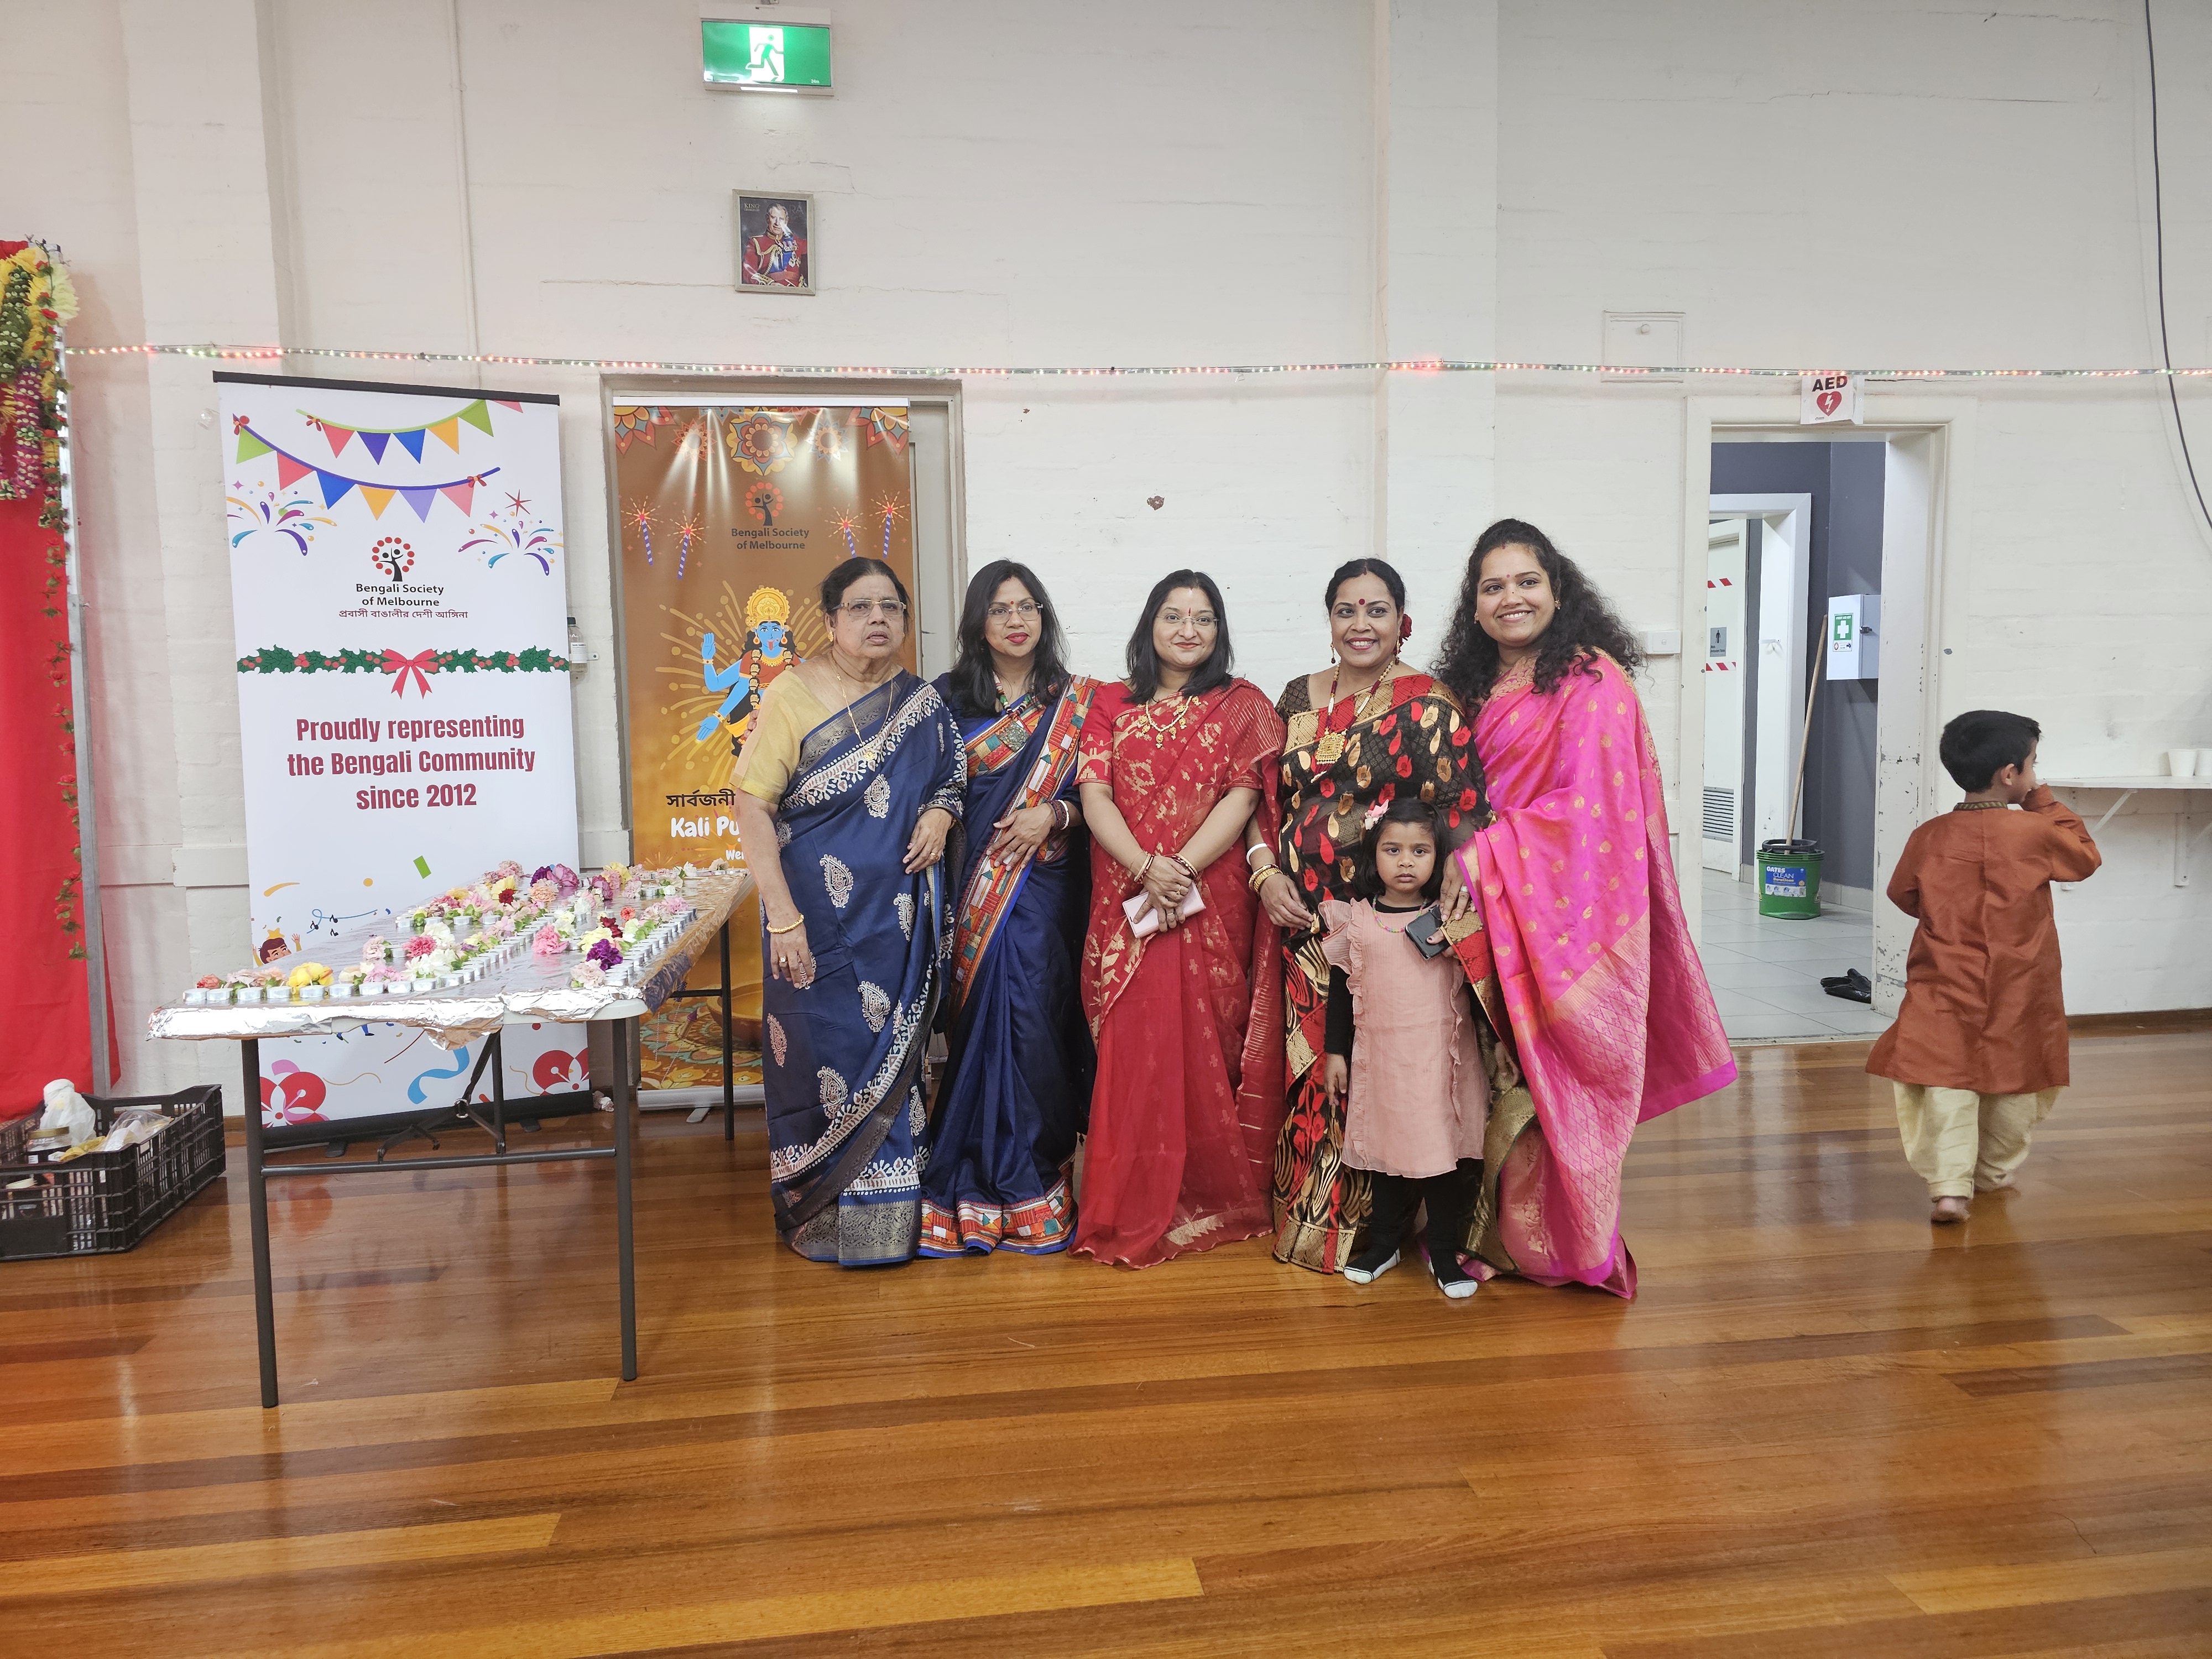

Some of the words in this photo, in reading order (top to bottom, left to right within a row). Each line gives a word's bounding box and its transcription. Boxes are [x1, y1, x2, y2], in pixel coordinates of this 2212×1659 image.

[1812, 376, 1848, 392] AED
[731, 528, 770, 539] Bengali
[772, 528, 810, 539] Society
[737, 540, 747, 549] of
[749, 541, 806, 549] Melbourne
[356, 583, 400, 594] Bengali
[403, 584, 444, 596] Society
[362, 597, 374, 606] of
[377, 597, 440, 606] Melbourne
[339, 608, 368, 618] প্রবাসী
[371, 609, 409, 618] বাঙালীর
[412, 609, 433, 618] দেশী
[435, 609, 468, 618] আঙ্গিনা
[296, 718, 380, 742] Proudly
[388, 715, 525, 742] representing
[287, 754, 324, 776] the
[331, 750, 412, 776] Bengali
[419, 748, 535, 772] Community
[356, 786, 419, 810] since
[426, 783, 477, 807] 2012
[666, 789, 736, 807] সার্বজনী
[671, 817, 710, 838] Kali
[717, 816, 740, 841] Pu
